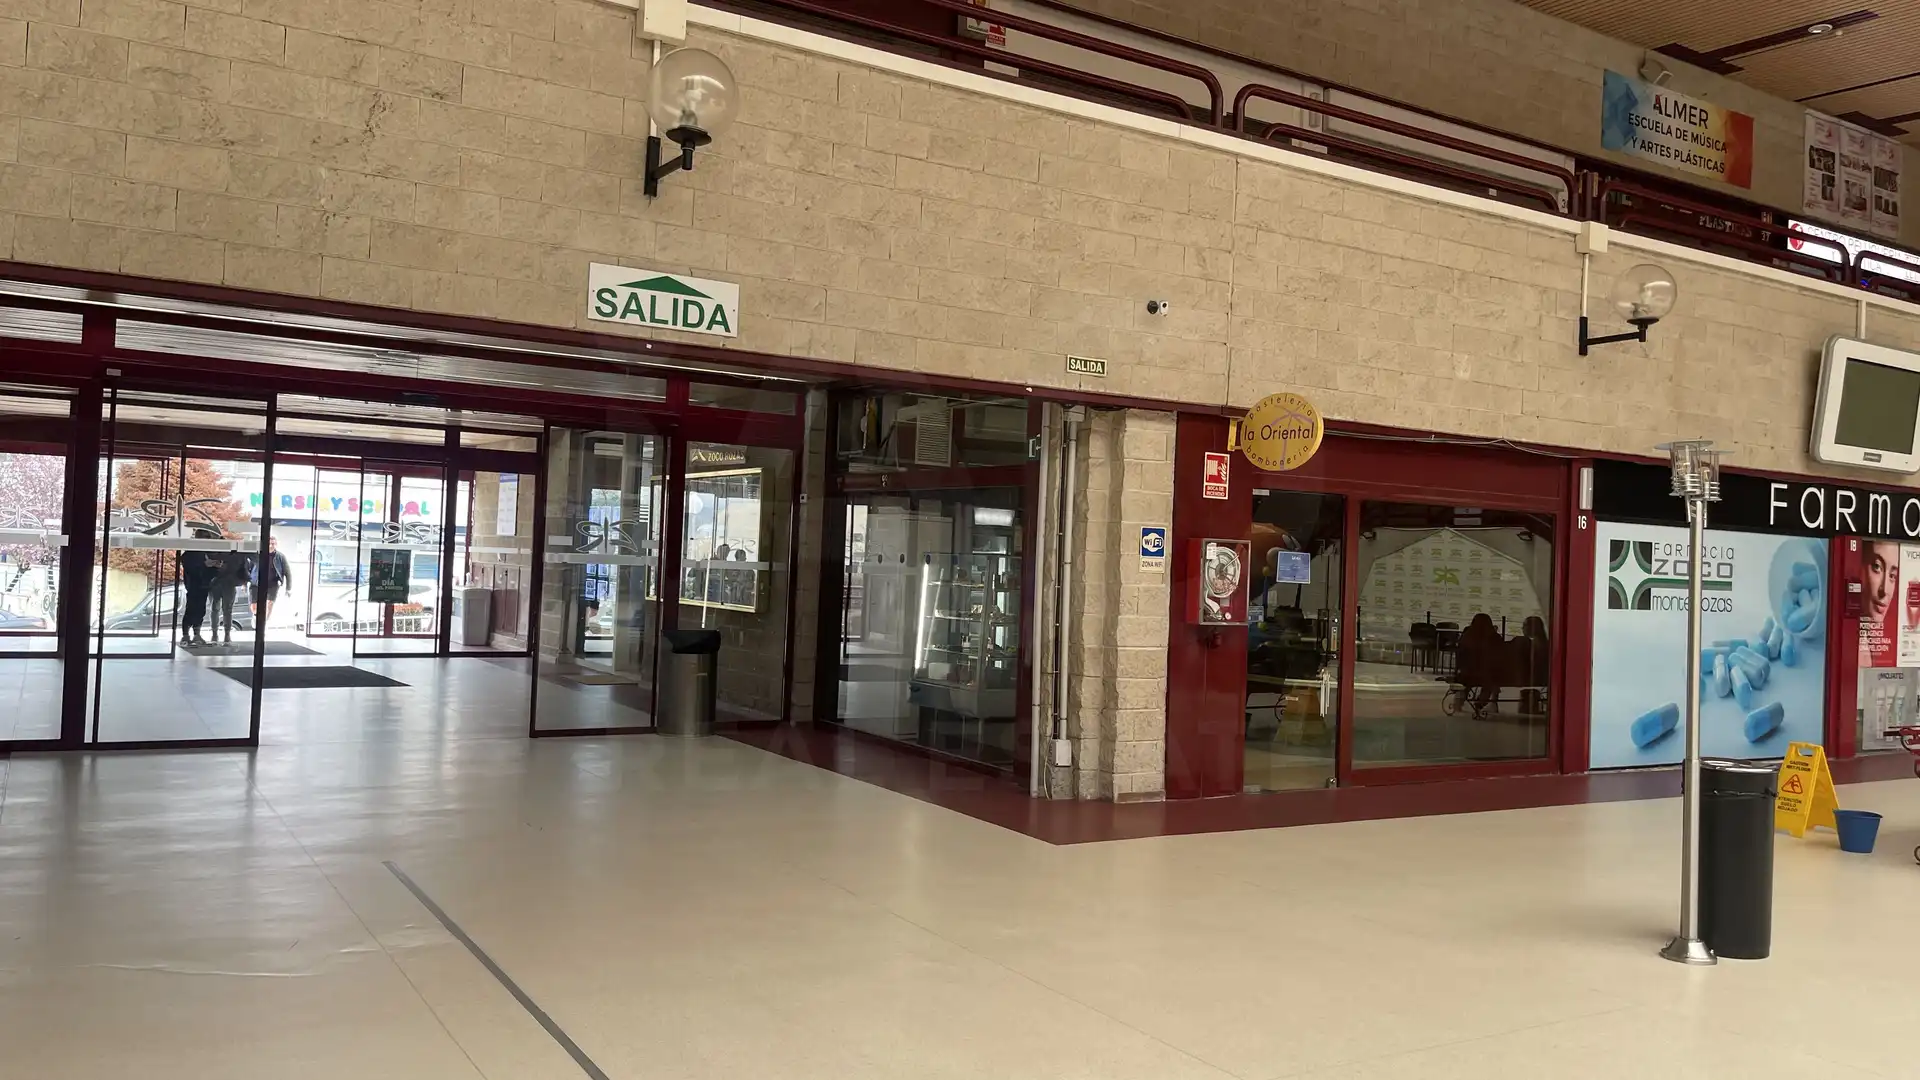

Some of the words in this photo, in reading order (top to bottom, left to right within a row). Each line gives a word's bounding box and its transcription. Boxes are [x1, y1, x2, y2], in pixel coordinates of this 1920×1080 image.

[1653, 94, 1708, 129] ALMER
[1628, 112, 1672, 138] ESCUELA
[1675, 127, 1688, 142] DE
[1690, 132, 1728, 154] MÚSICA
[1631, 136, 1638, 148] Y
[1640, 139, 1671, 159] ARTES
[1674, 147, 1725, 174] PLÁSTICAS
[594, 287, 732, 334] SALIDA
[1070, 358, 1103, 373] SALIDA
[1244, 425, 1255, 441] la
[1260, 421, 1315, 441] Oriental
[1577, 516, 1587, 530] 16
[1850, 540, 1857, 552] 18
[1652, 594, 1734, 613] monteozas
